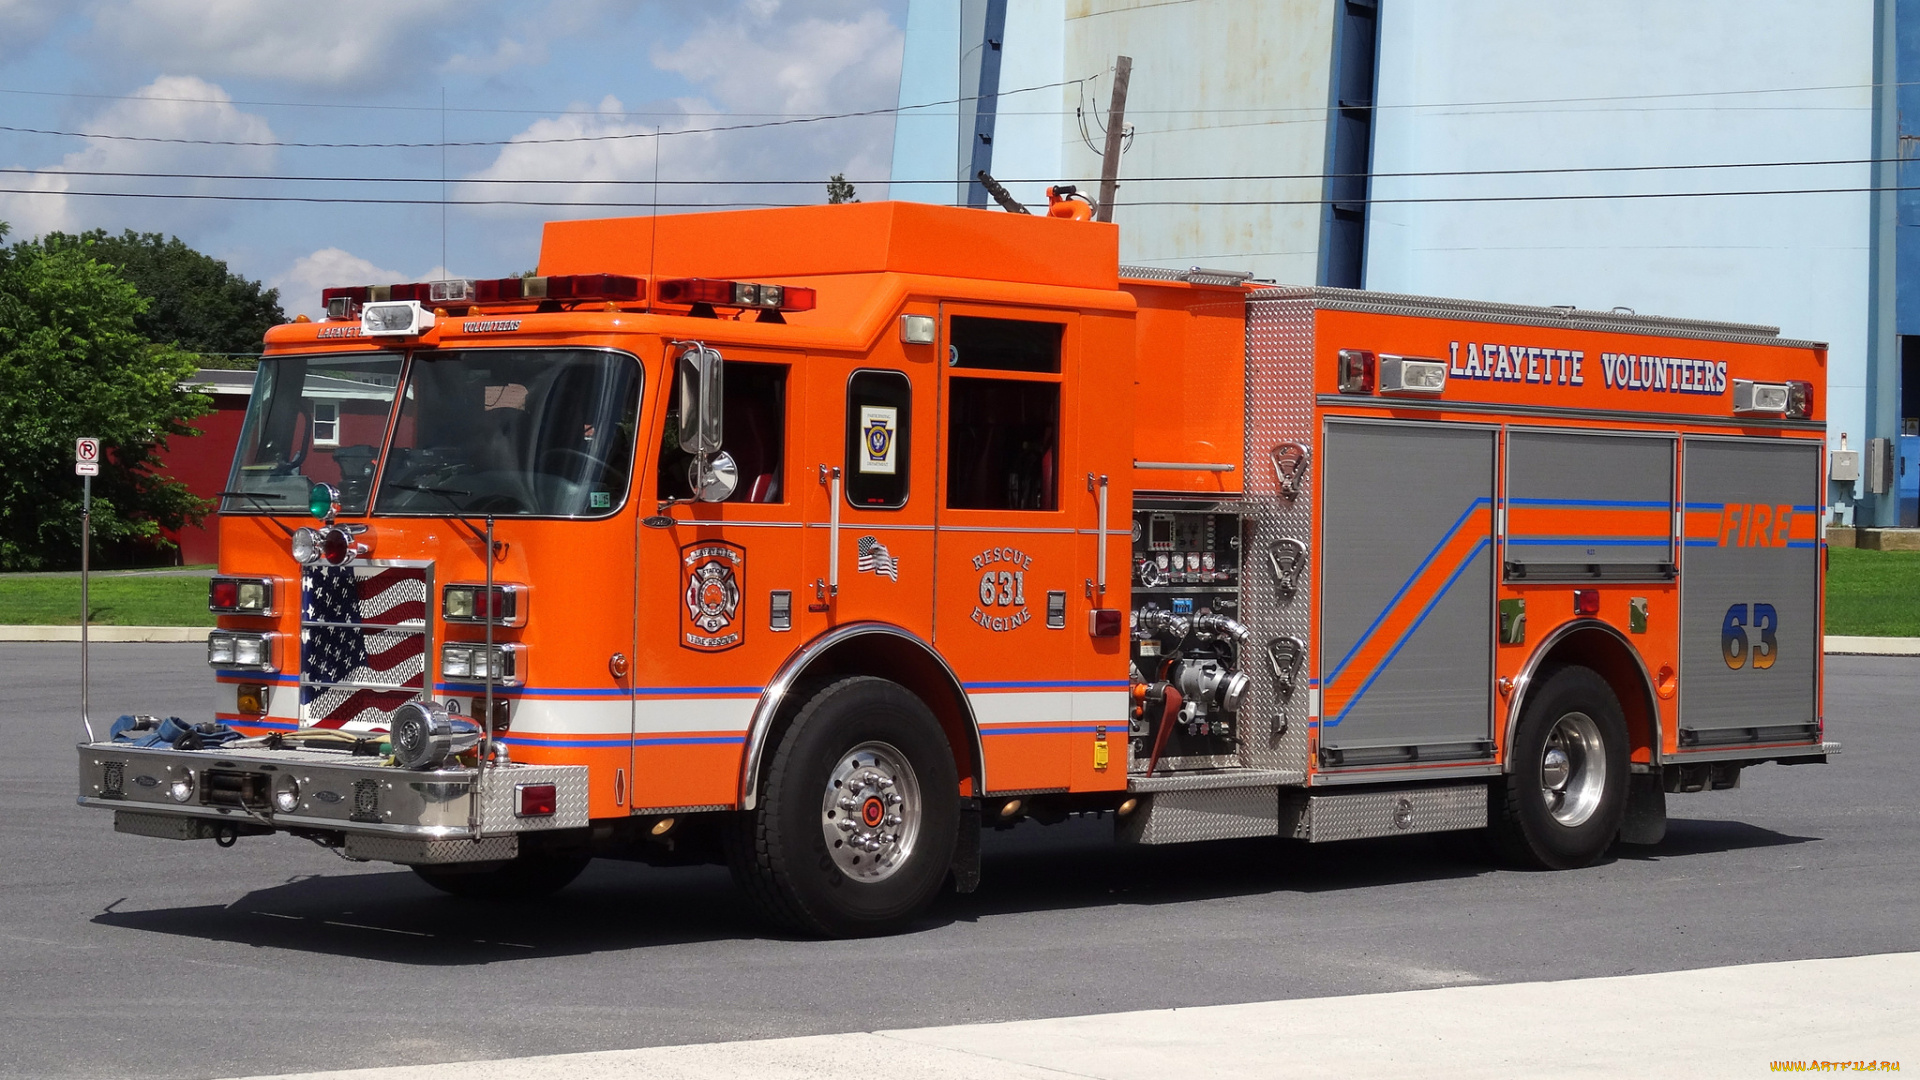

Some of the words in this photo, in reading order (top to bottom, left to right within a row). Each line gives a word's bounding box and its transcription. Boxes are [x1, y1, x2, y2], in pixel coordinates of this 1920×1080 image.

[462, 319, 522, 333] VOLUNTEERS
[1450, 341, 1584, 386] LAFAYETTE
[1601, 351, 1728, 396] VOLUNTEERS
[1718, 503, 1793, 548] FIRE
[702, 567, 725, 576] STATION
[972, 546, 1033, 572] RESCUE
[979, 570, 1025, 607] 631
[707, 619, 718, 628] 63
[970, 606, 1032, 632] ENGINE
[1721, 603, 1778, 670] 63
